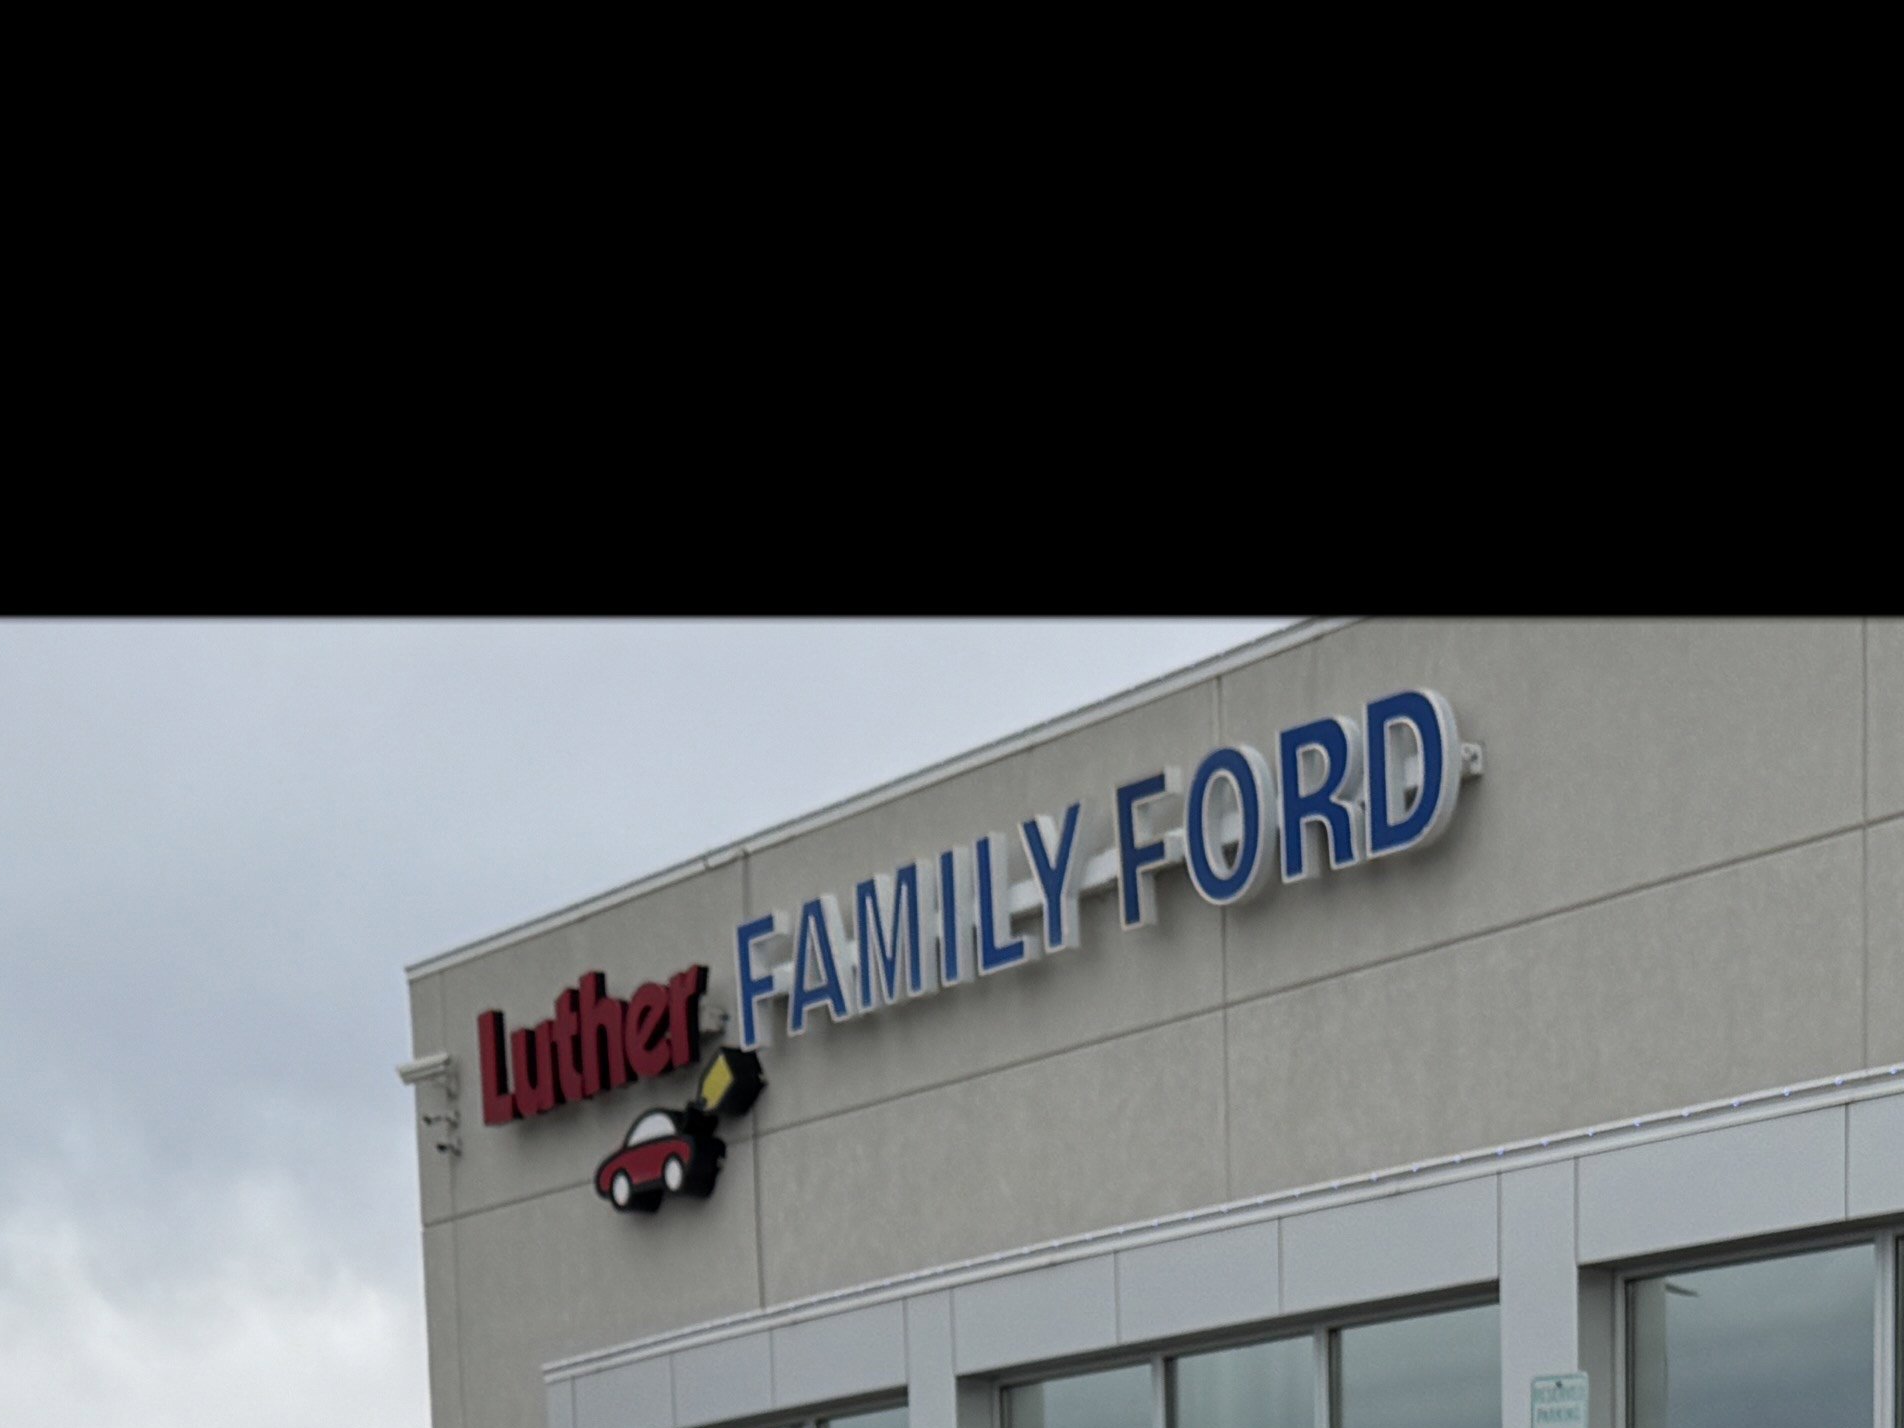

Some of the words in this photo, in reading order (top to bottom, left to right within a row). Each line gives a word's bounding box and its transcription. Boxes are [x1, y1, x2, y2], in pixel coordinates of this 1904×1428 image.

[735, 802, 1086, 1051] FAMILY
[1114, 686, 1462, 931] FORD
[478, 963, 708, 1126] Luther
